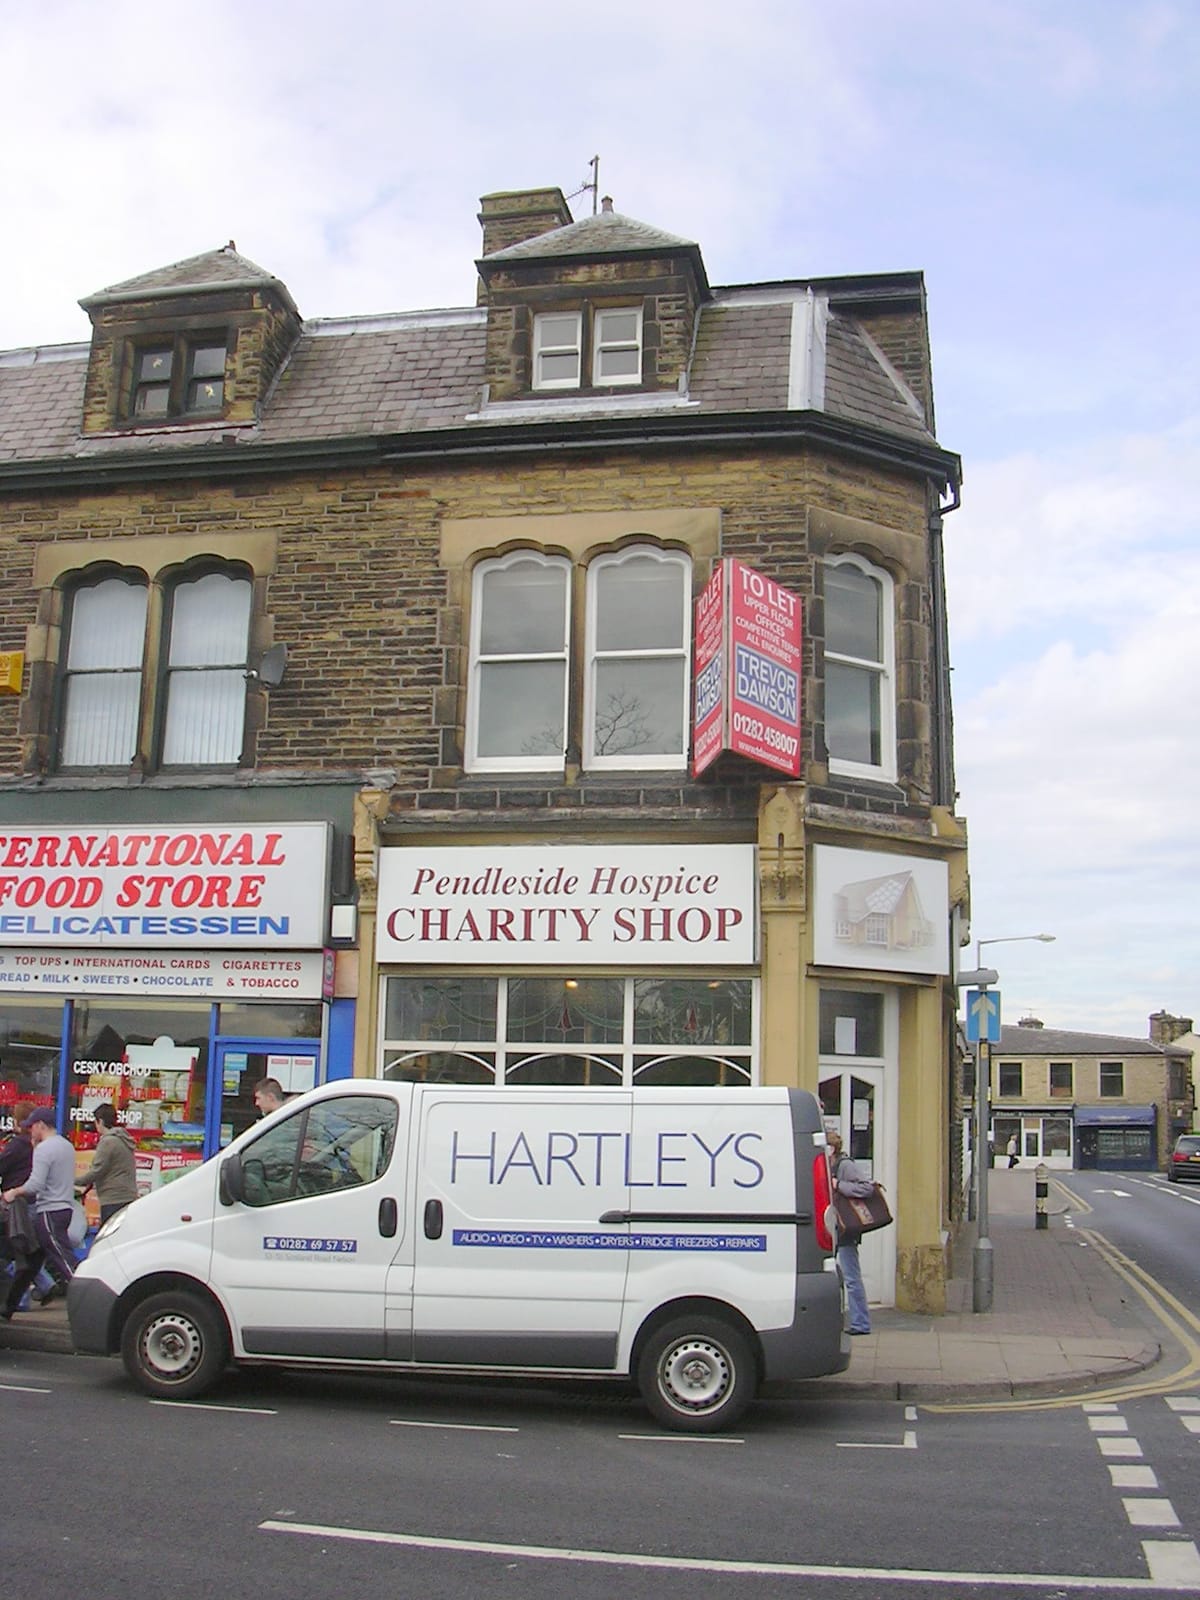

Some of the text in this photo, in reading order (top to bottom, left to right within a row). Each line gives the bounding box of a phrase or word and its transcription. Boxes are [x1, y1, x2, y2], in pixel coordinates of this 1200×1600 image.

[739, 566, 796, 617] TO LET
[743, 594, 794, 631] UPPER FLOOR
[755, 613, 786, 637] OFFICES
[746, 632, 761, 647] ALL
[738, 650, 796, 698] TREVOR
[738, 672, 796, 720] DAWSON
[733, 711, 764, 742] 01282
[764, 726, 798, 757] 458007
[0, 833, 286, 868] ERNATIONAL
[0, 874, 266, 909] FOOD STORE
[410, 867, 719, 902] Pendleside Hospice
[0, 915, 290, 935] ELICATESSEN
[386, 907, 743, 943] CHARITY SHOP
[15, 956, 37, 966] TOP
[40, 957, 62, 967] UPS
[72, 958, 166, 969] INTERNATIONAL
[170, 959, 211, 969] CARDS
[222, 960, 302, 972] CIGARETTES
[42, 974, 71, 984] MILK
[82, 975, 130, 986] SWEETS
[141, 975, 214, 988] CHOCOLATE
[226, 978, 300, 989] & TOBACCO
[108, 1062, 152, 1077] OBCHOD
[451, 1131, 764, 1188] HARTLEYS
[280, 1239, 355, 1251] 01282 69 57 57
[460, 1233, 760, 1248] AUDIO VIDEO TV WASHERS DRYERS FRIDGE FREEZERS REPAIRS
